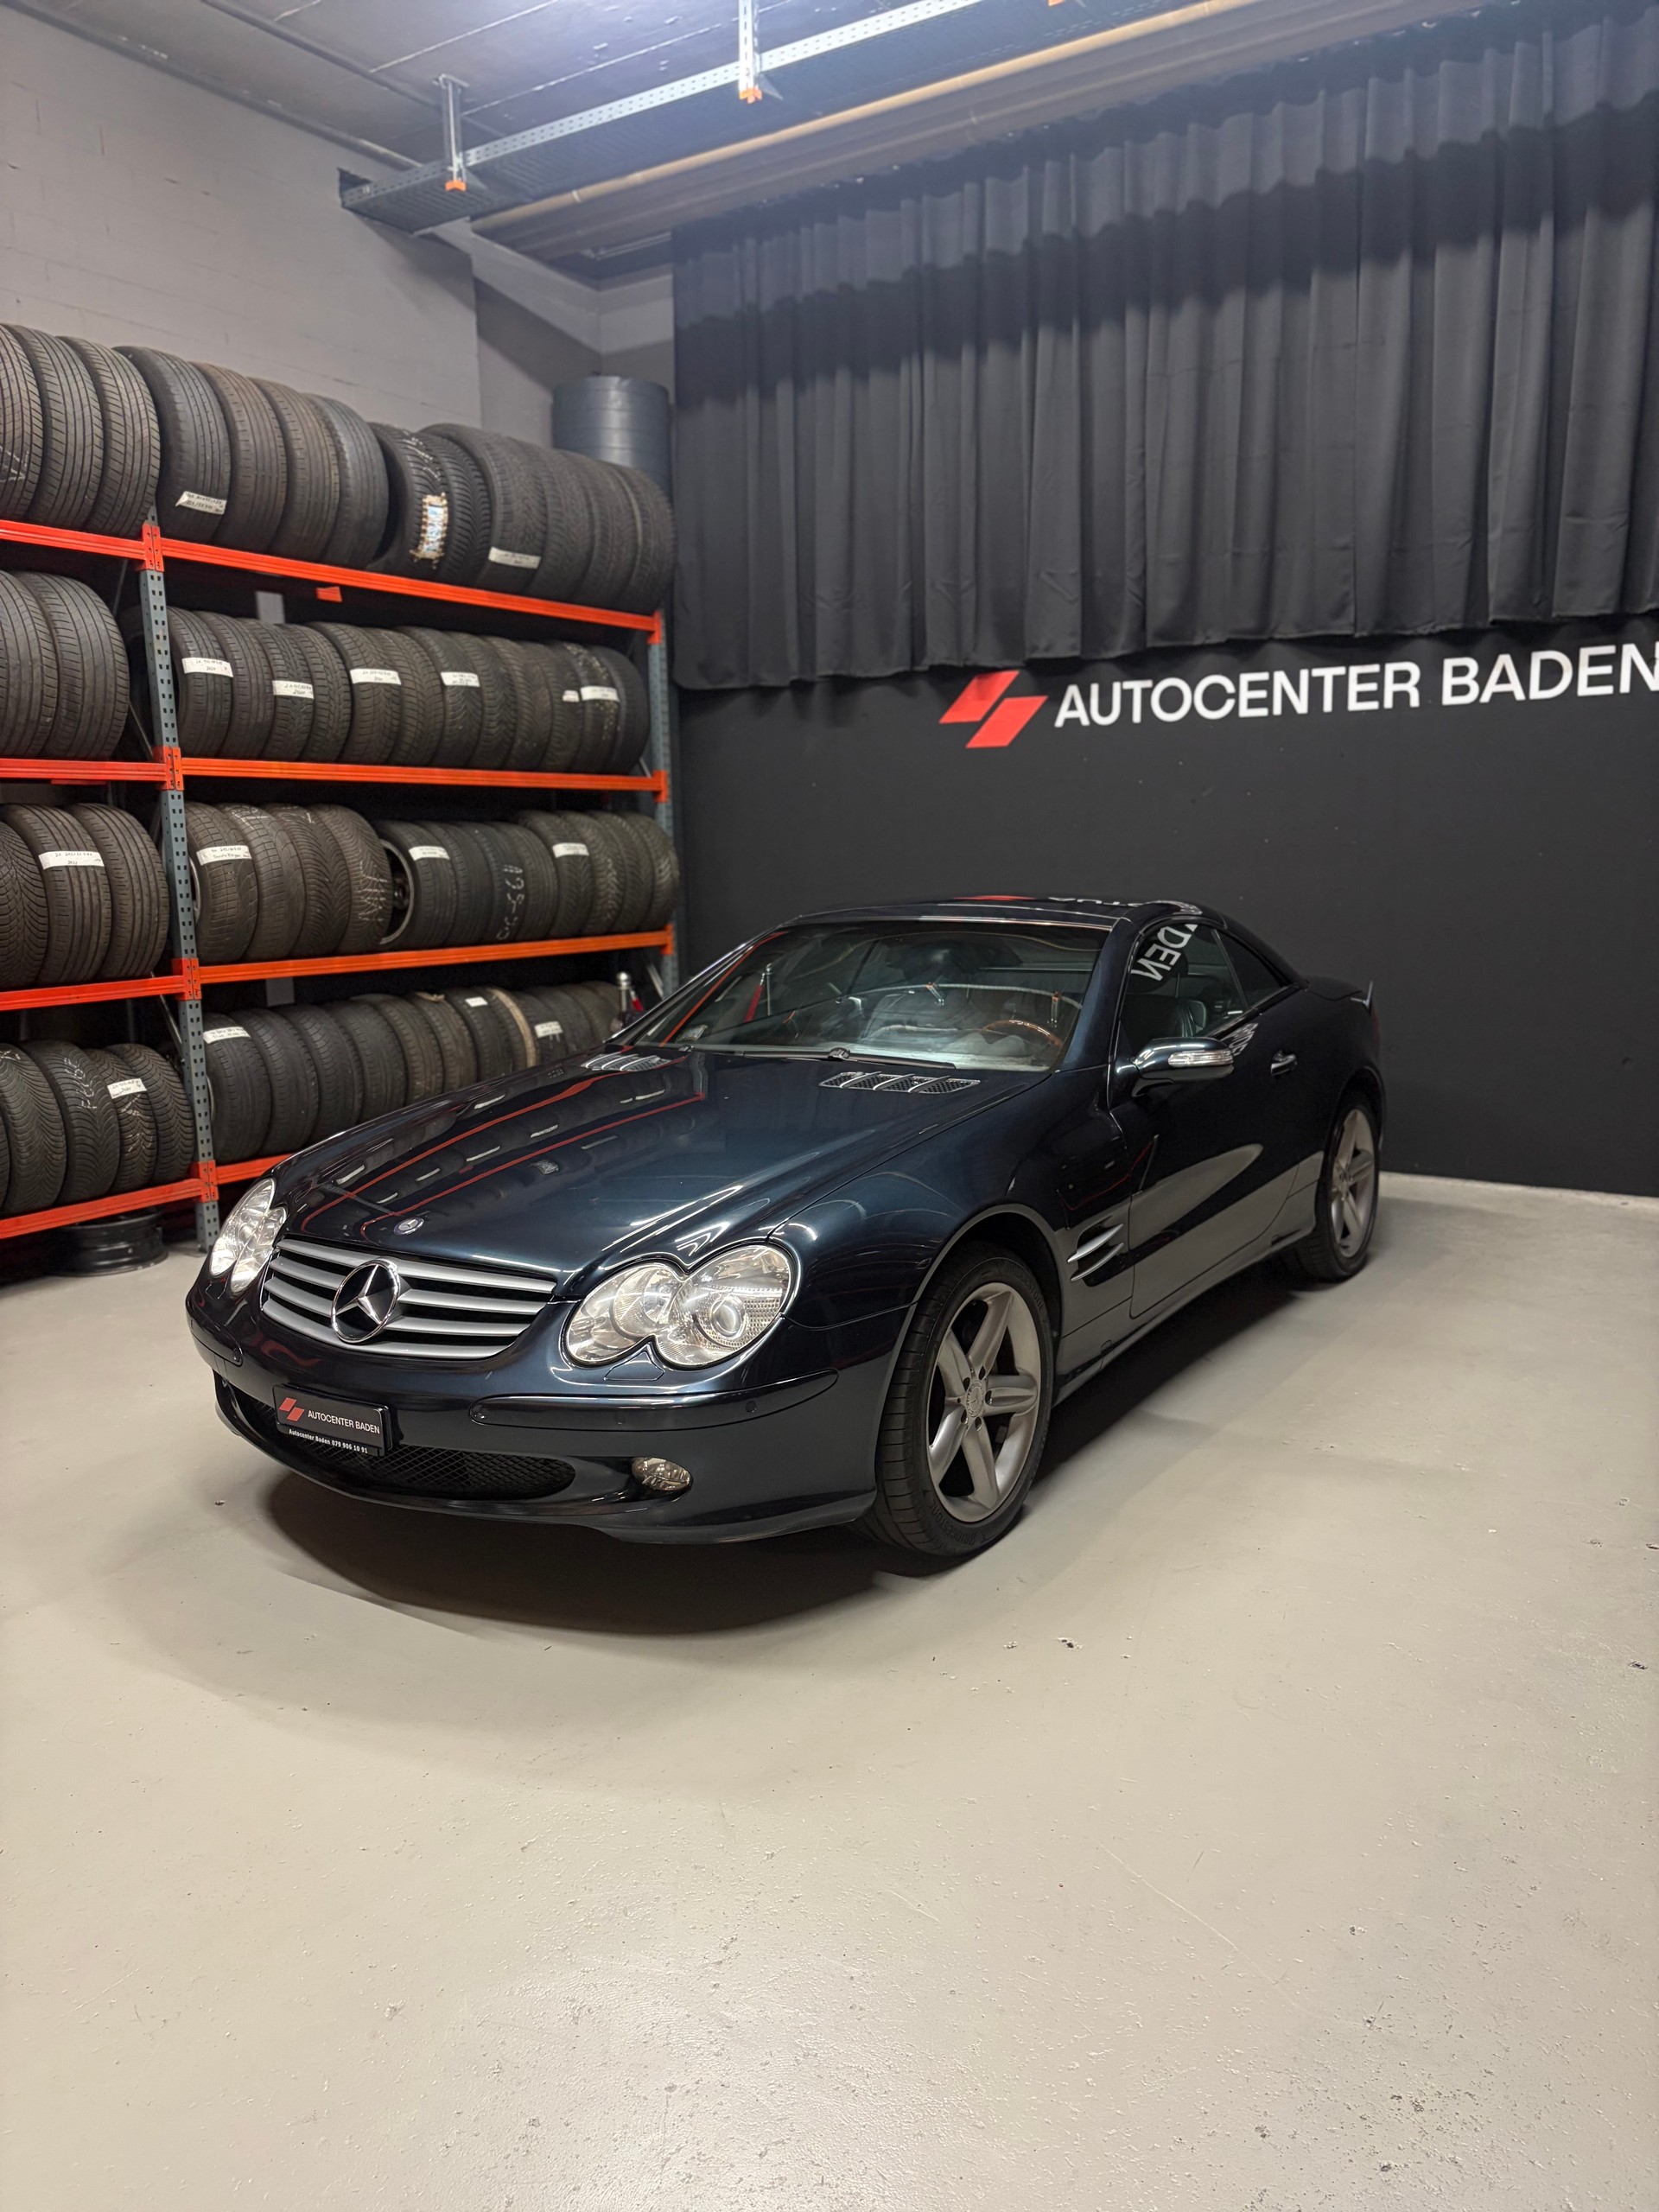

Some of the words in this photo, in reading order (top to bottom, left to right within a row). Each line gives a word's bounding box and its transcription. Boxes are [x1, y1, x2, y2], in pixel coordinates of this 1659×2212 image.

[1054, 661, 1421, 728] AUTOCENTER
[1442, 640, 1659, 706] BADEN
[308, 1409, 354, 1428] AUTOCENTER
[355, 1421, 380, 1434] BADEN
[289, 1428, 315, 1440] Autocenter
[315, 1435, 330, 1445] Baden
